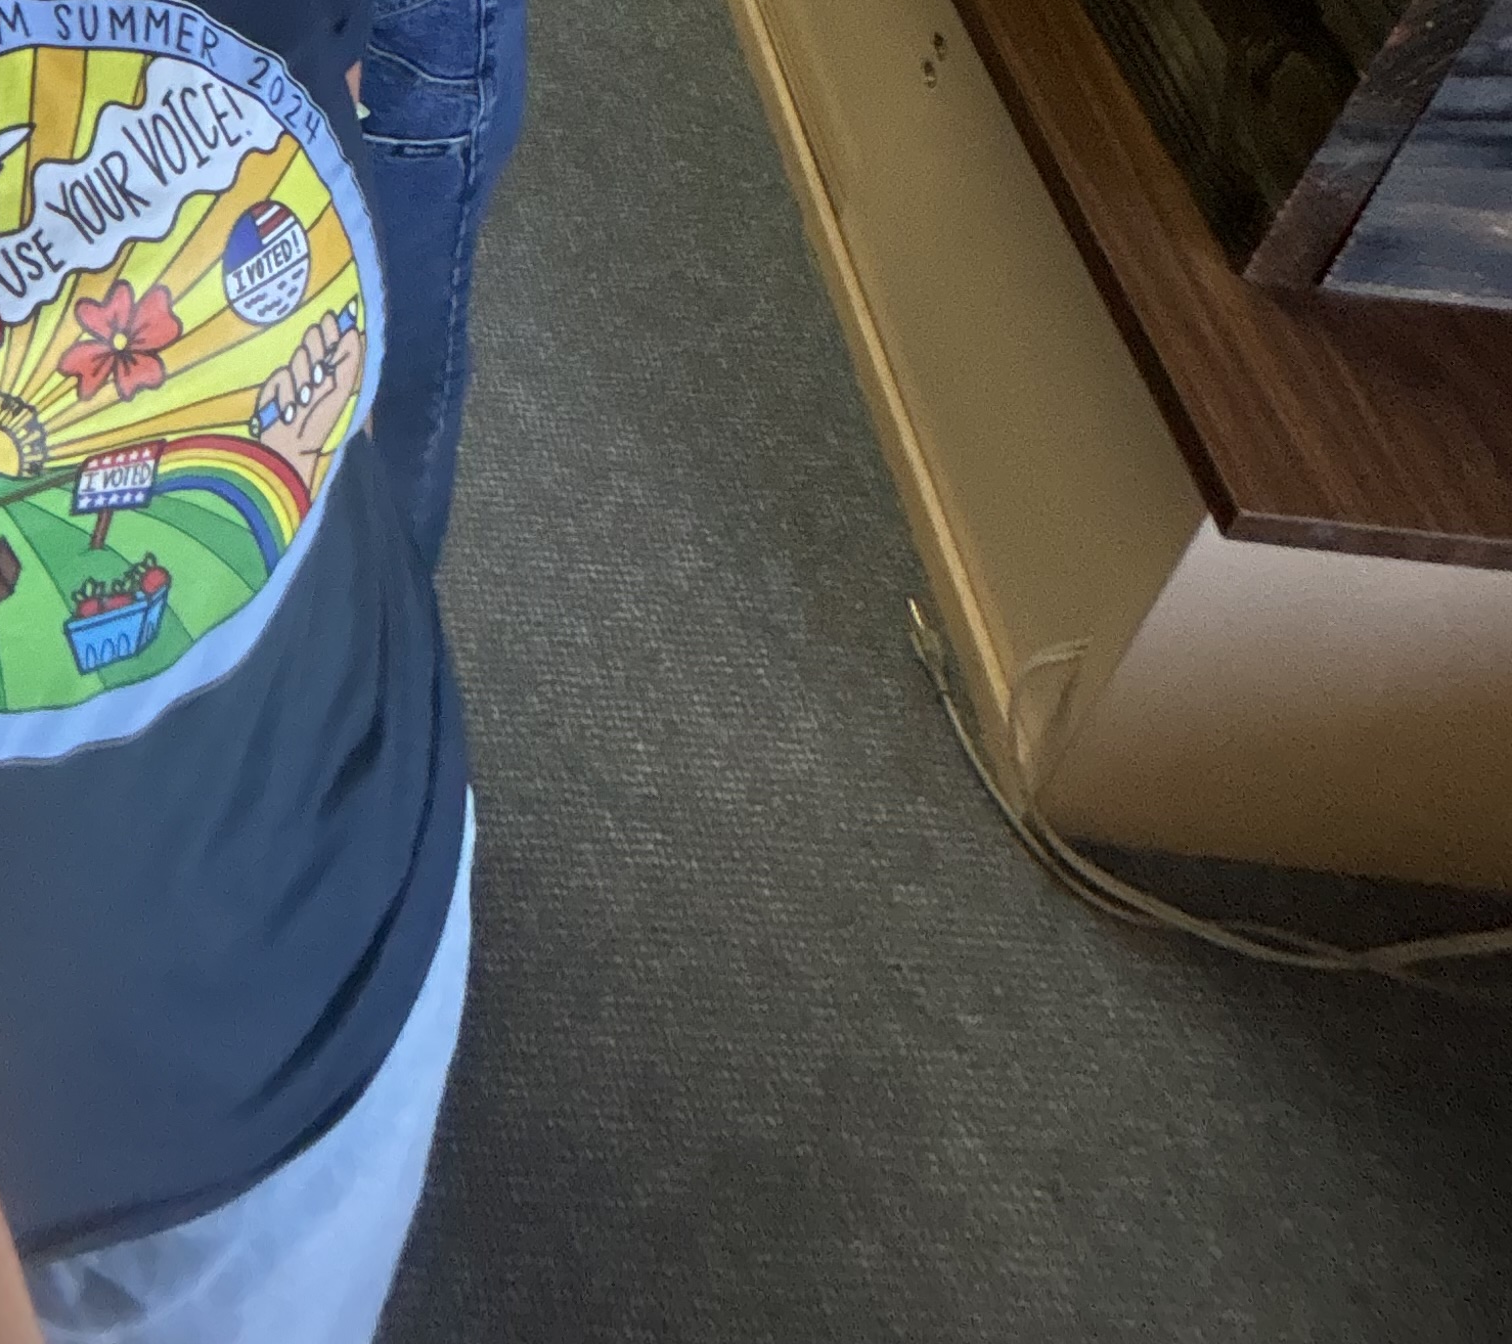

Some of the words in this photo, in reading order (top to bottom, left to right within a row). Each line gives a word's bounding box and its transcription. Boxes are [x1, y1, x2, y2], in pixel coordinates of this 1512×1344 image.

[54, 4, 219, 67] SUMMER
[247, 56, 322, 145] 2024
[45, 151, 150, 244] YOUR
[121, 82, 253, 186] VOICE!
[232, 269, 247, 294] I
[246, 229, 301, 286] VOTED!
[82, 472, 100, 492] I
[103, 461, 152, 490] VOTED
